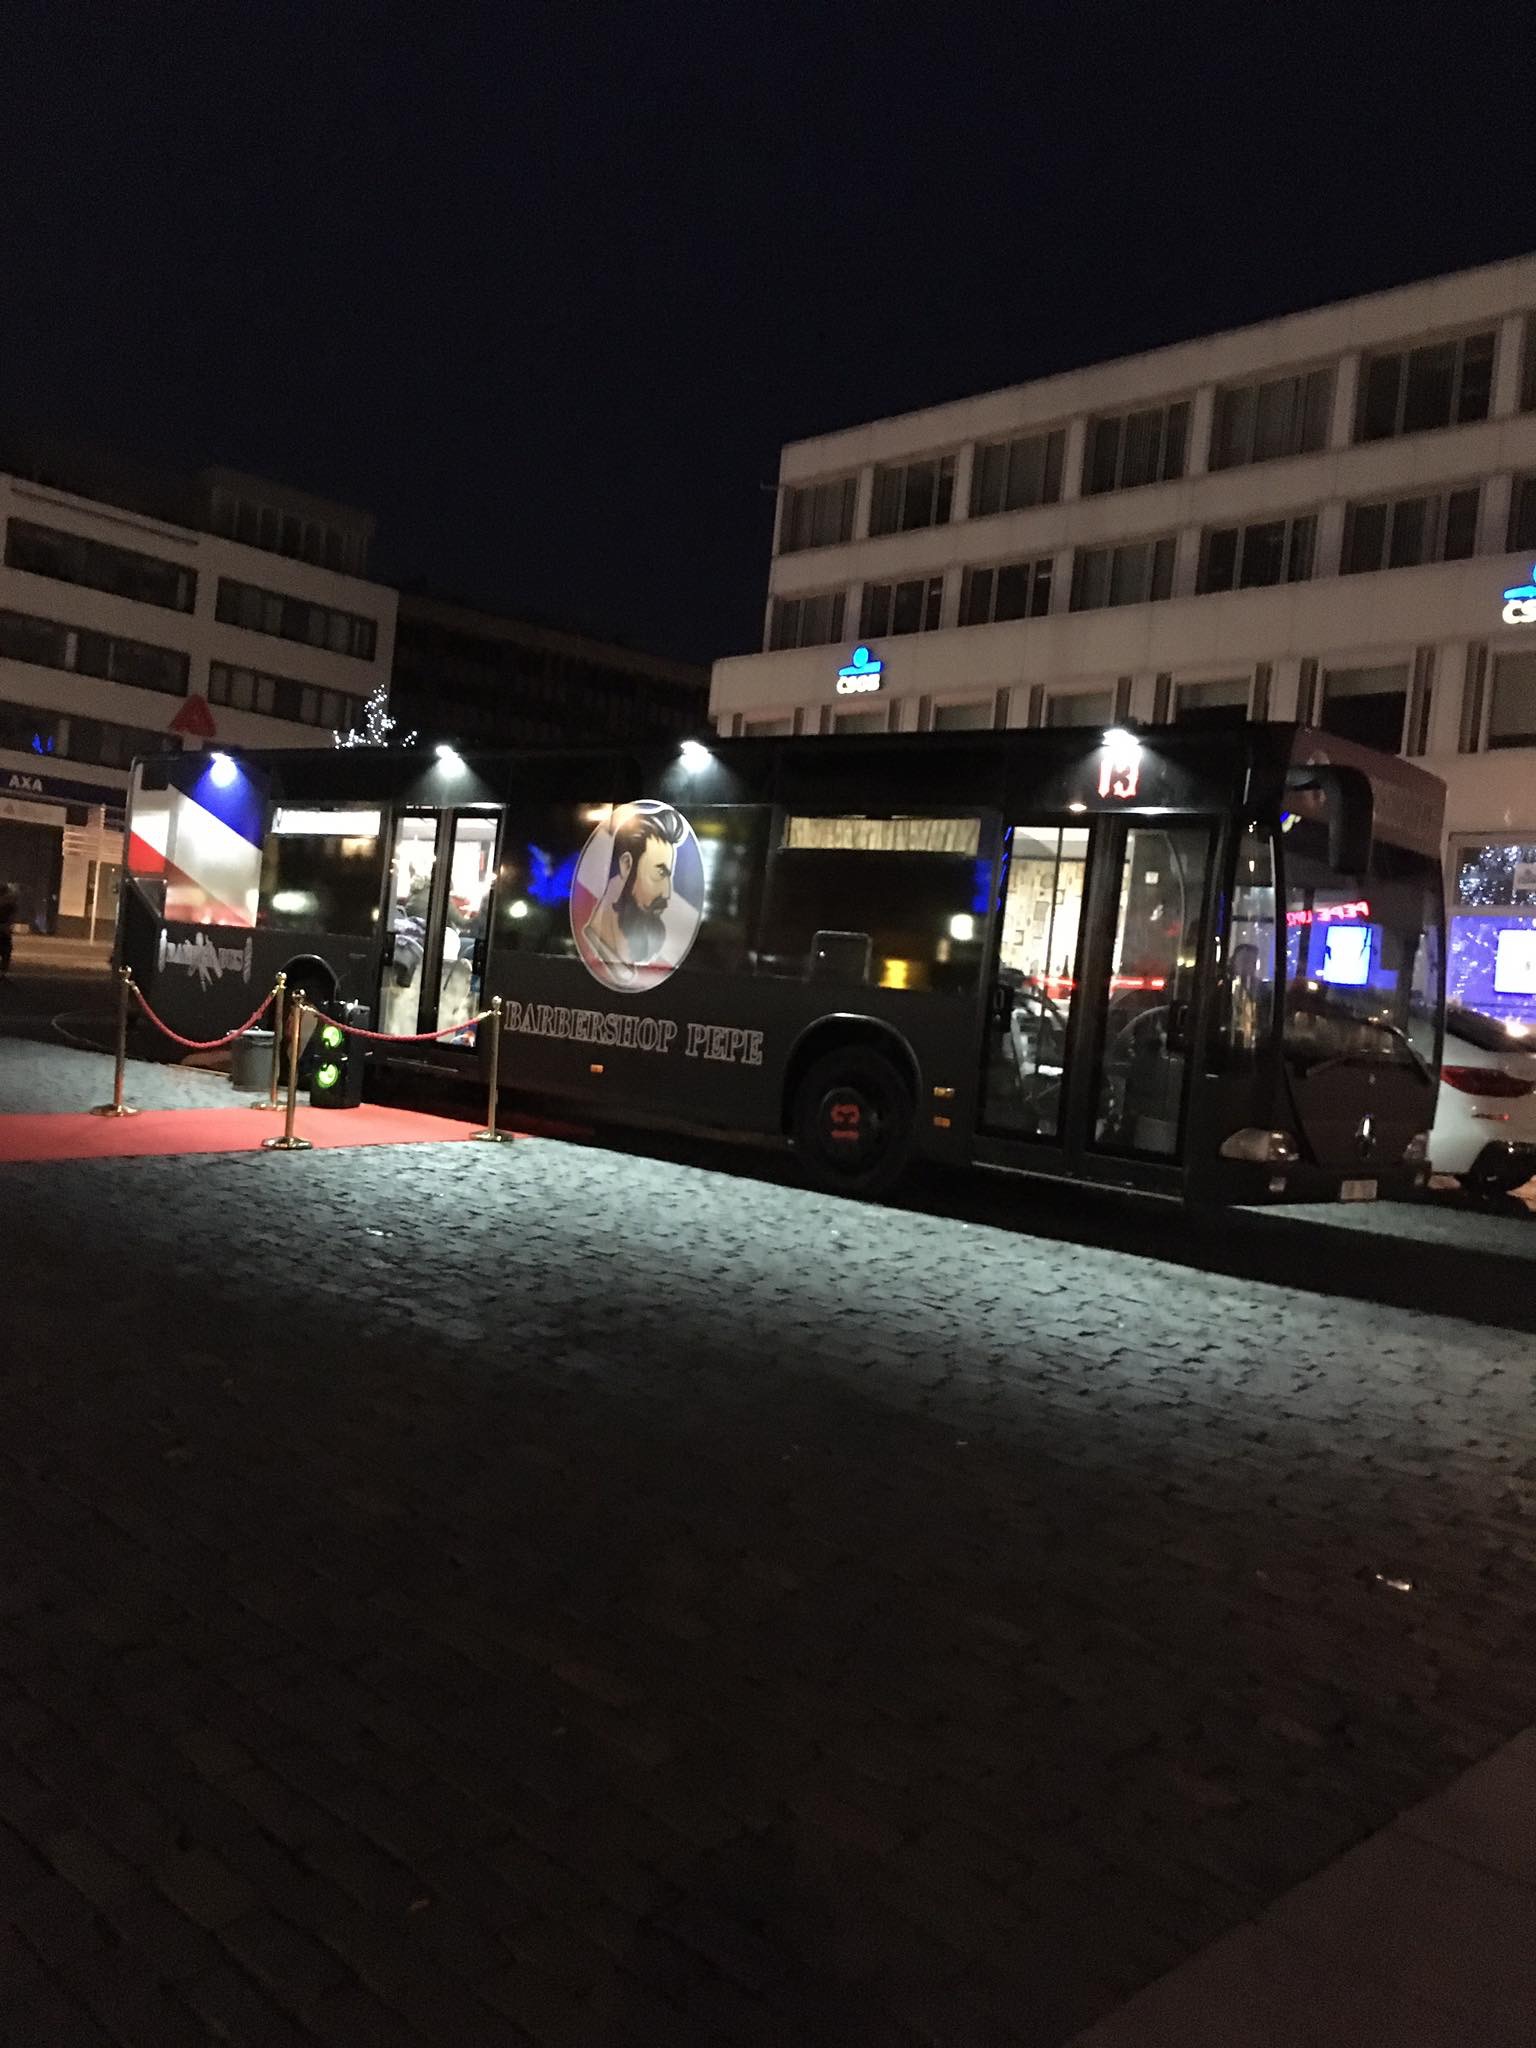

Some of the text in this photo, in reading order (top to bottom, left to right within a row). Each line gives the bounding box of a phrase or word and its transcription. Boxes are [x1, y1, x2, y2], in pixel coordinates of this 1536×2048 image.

[8, 774, 44, 792] AXA
[503, 1000, 764, 1066] BARBERSHOP PEPE
